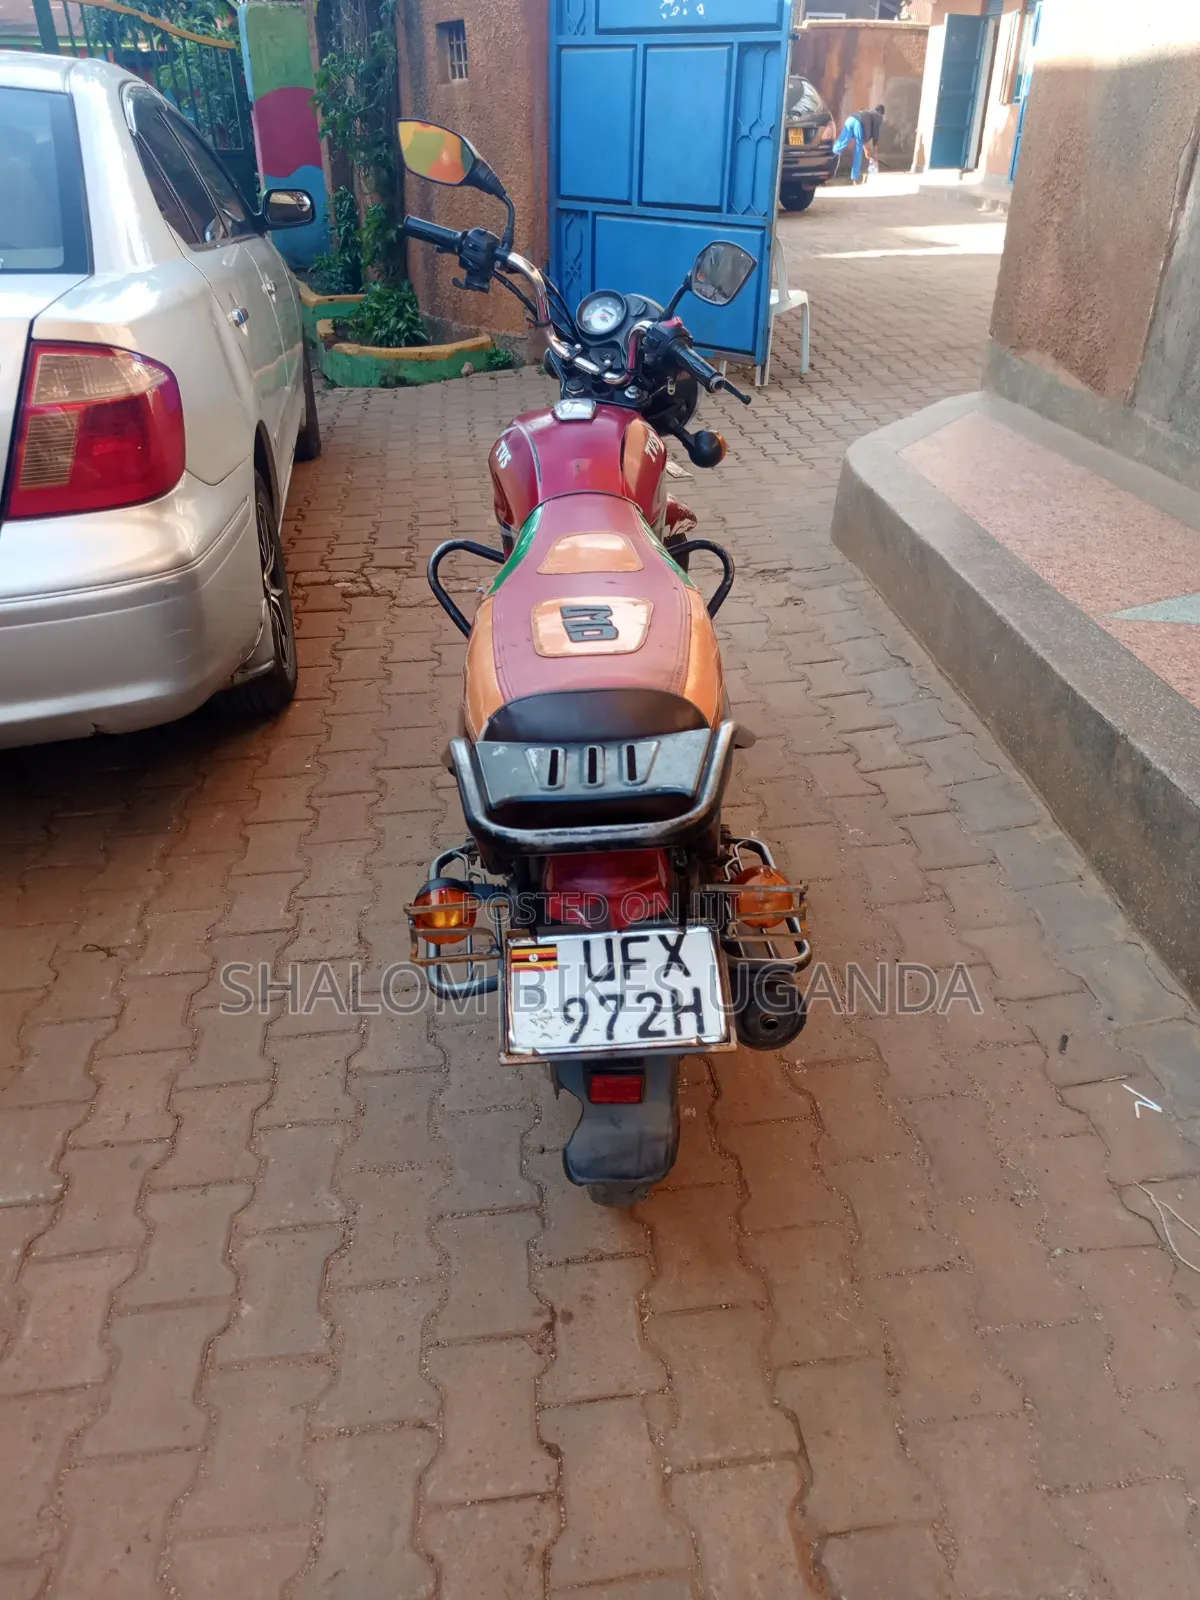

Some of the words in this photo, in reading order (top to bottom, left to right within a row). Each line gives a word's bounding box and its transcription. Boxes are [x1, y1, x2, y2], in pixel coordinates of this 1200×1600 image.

[495, 440, 512, 468] TVS
[582, 933, 692, 982] UFX
[563, 987, 706, 1044] 972H
